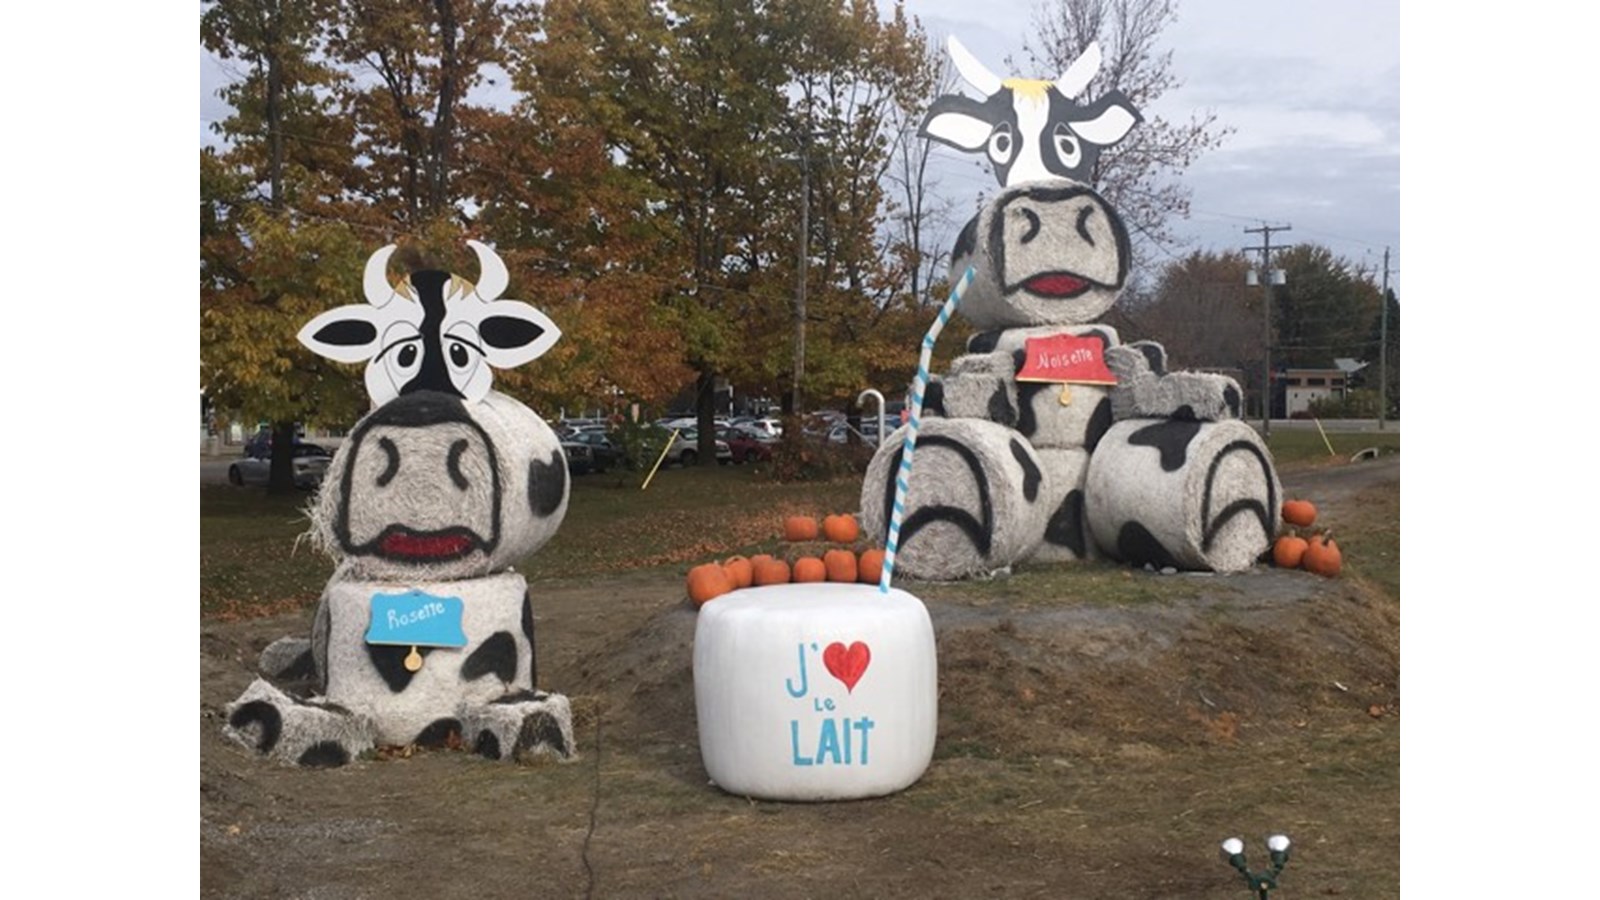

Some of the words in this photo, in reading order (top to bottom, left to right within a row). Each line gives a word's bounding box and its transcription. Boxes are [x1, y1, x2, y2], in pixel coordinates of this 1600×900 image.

[1037, 348, 1094, 369] Noisette
[387, 602, 446, 630] Rosette
[786, 643, 818, 698] J'
